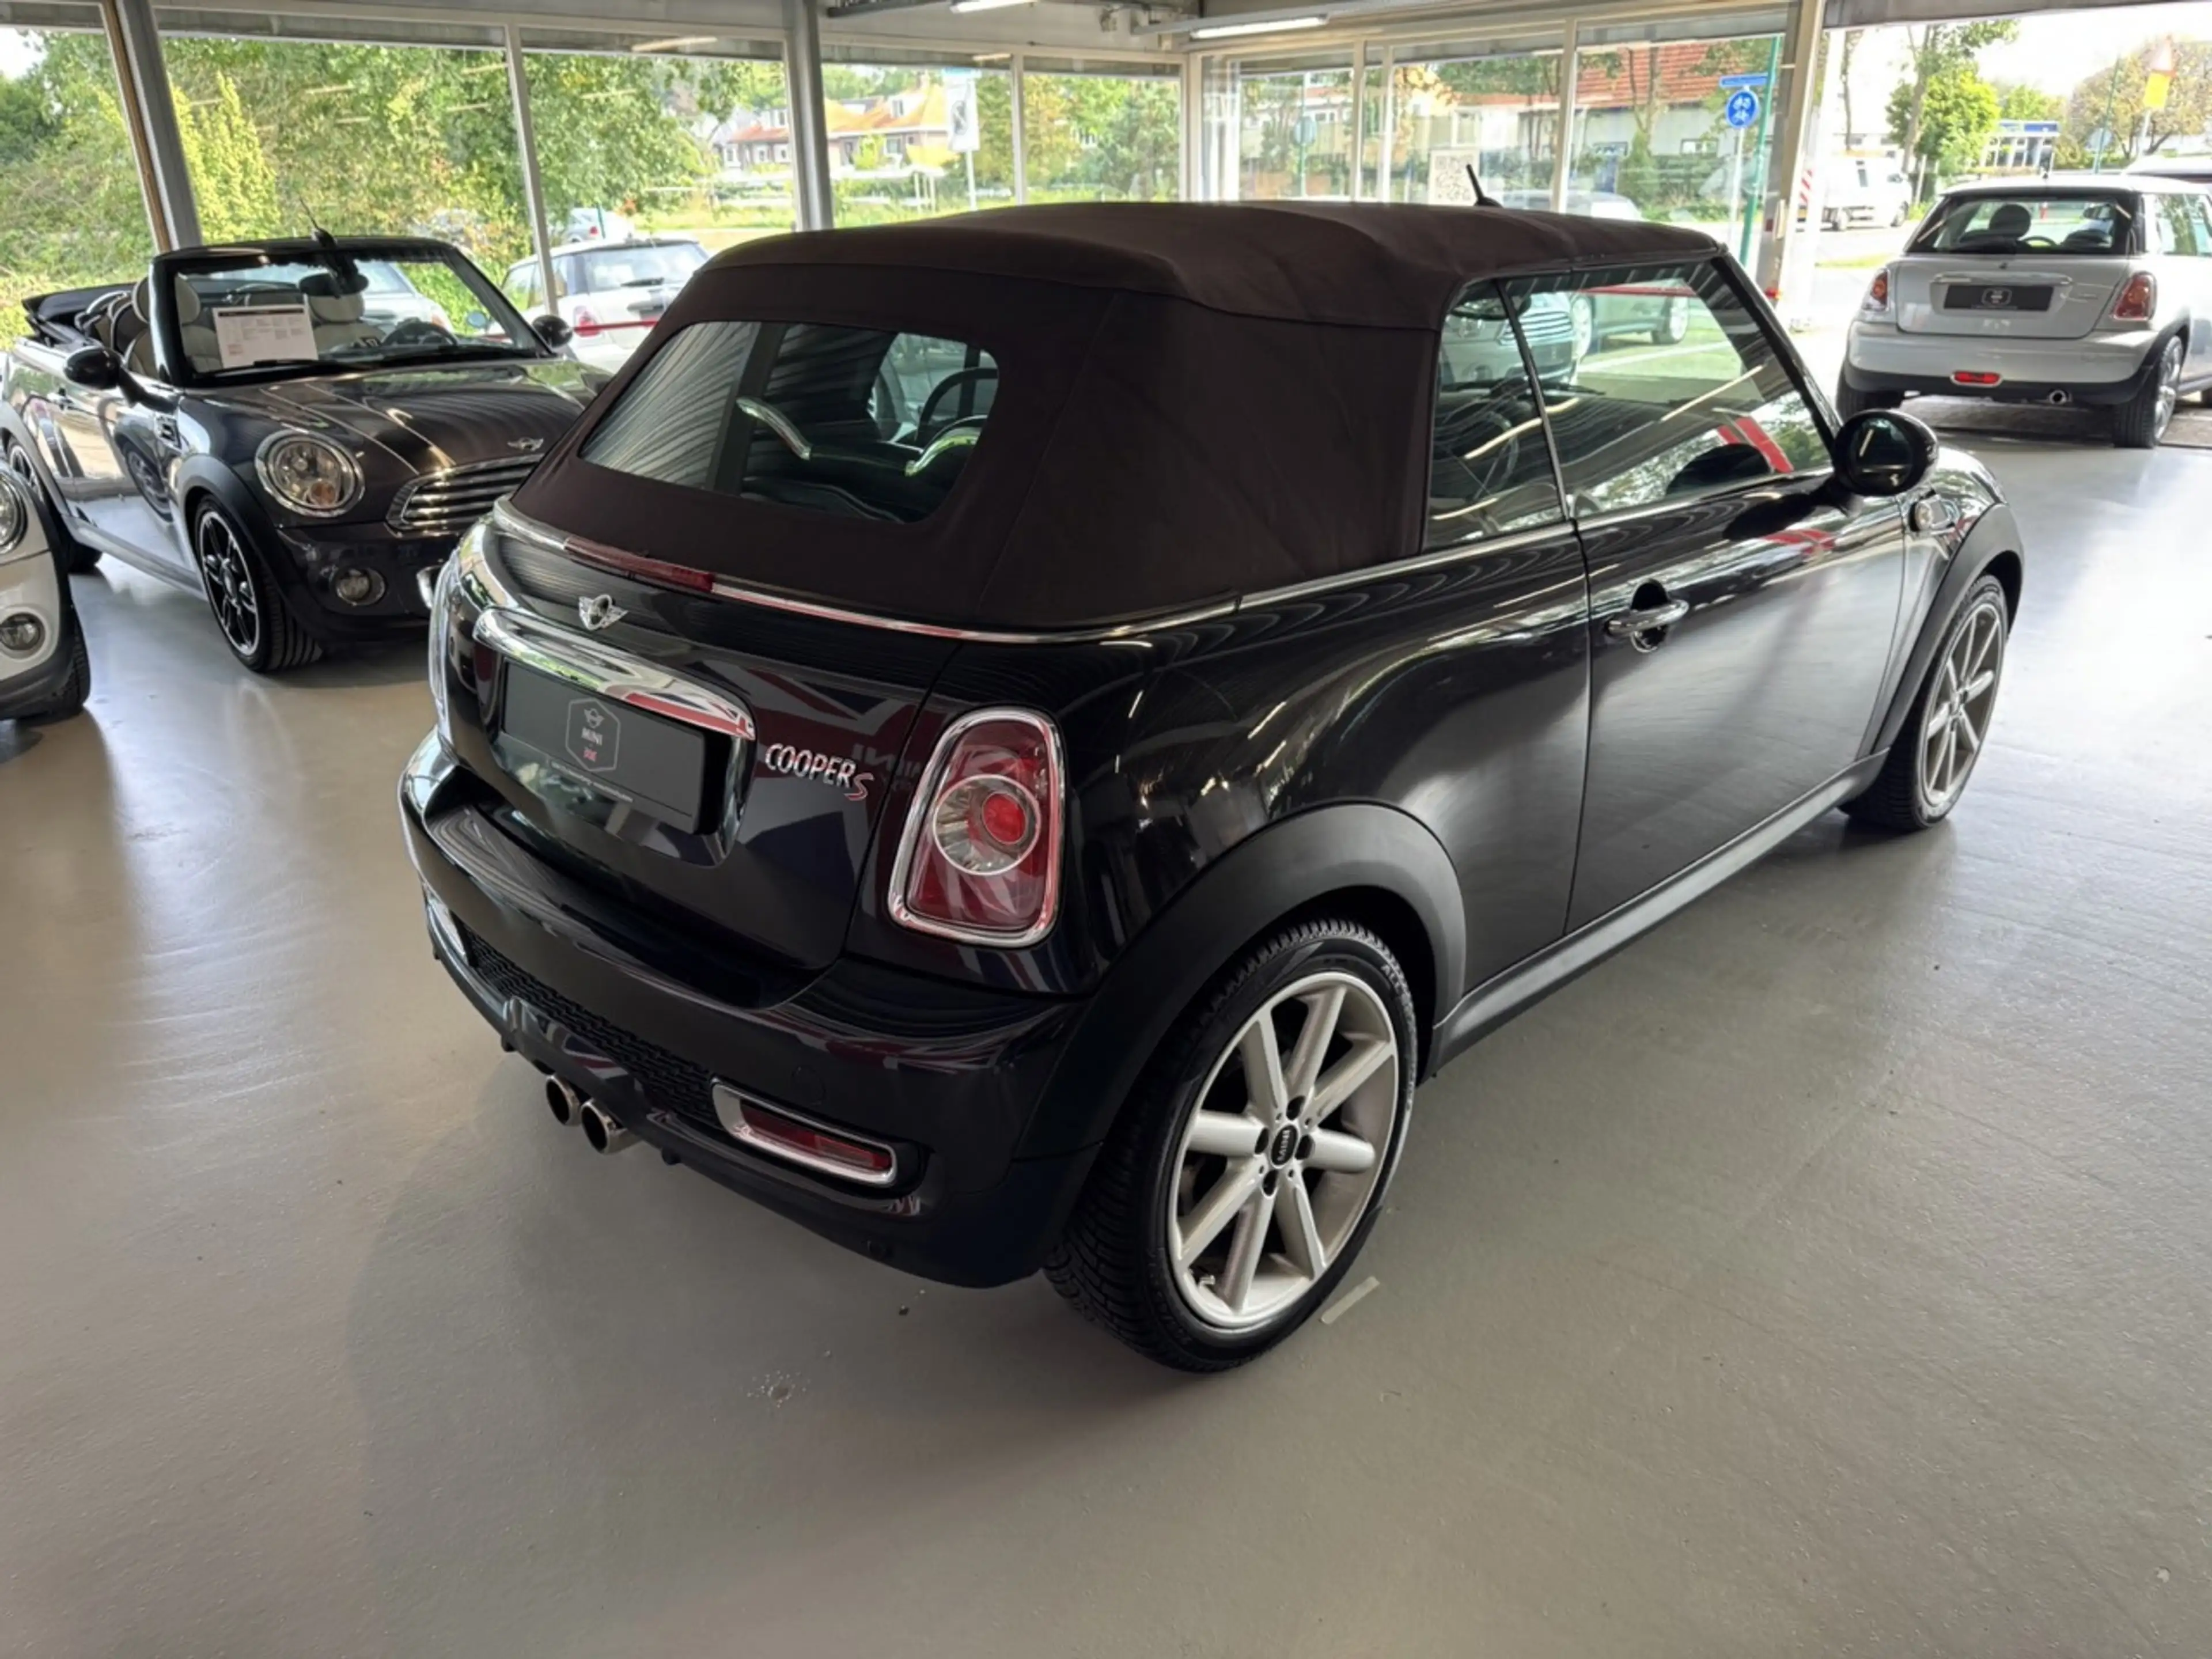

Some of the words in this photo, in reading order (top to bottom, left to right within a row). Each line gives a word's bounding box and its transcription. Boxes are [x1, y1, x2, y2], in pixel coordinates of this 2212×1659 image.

[765, 743, 857, 789] COOPER
[843, 772, 874, 801] S
[1277, 1130, 1290, 1162] MINI
